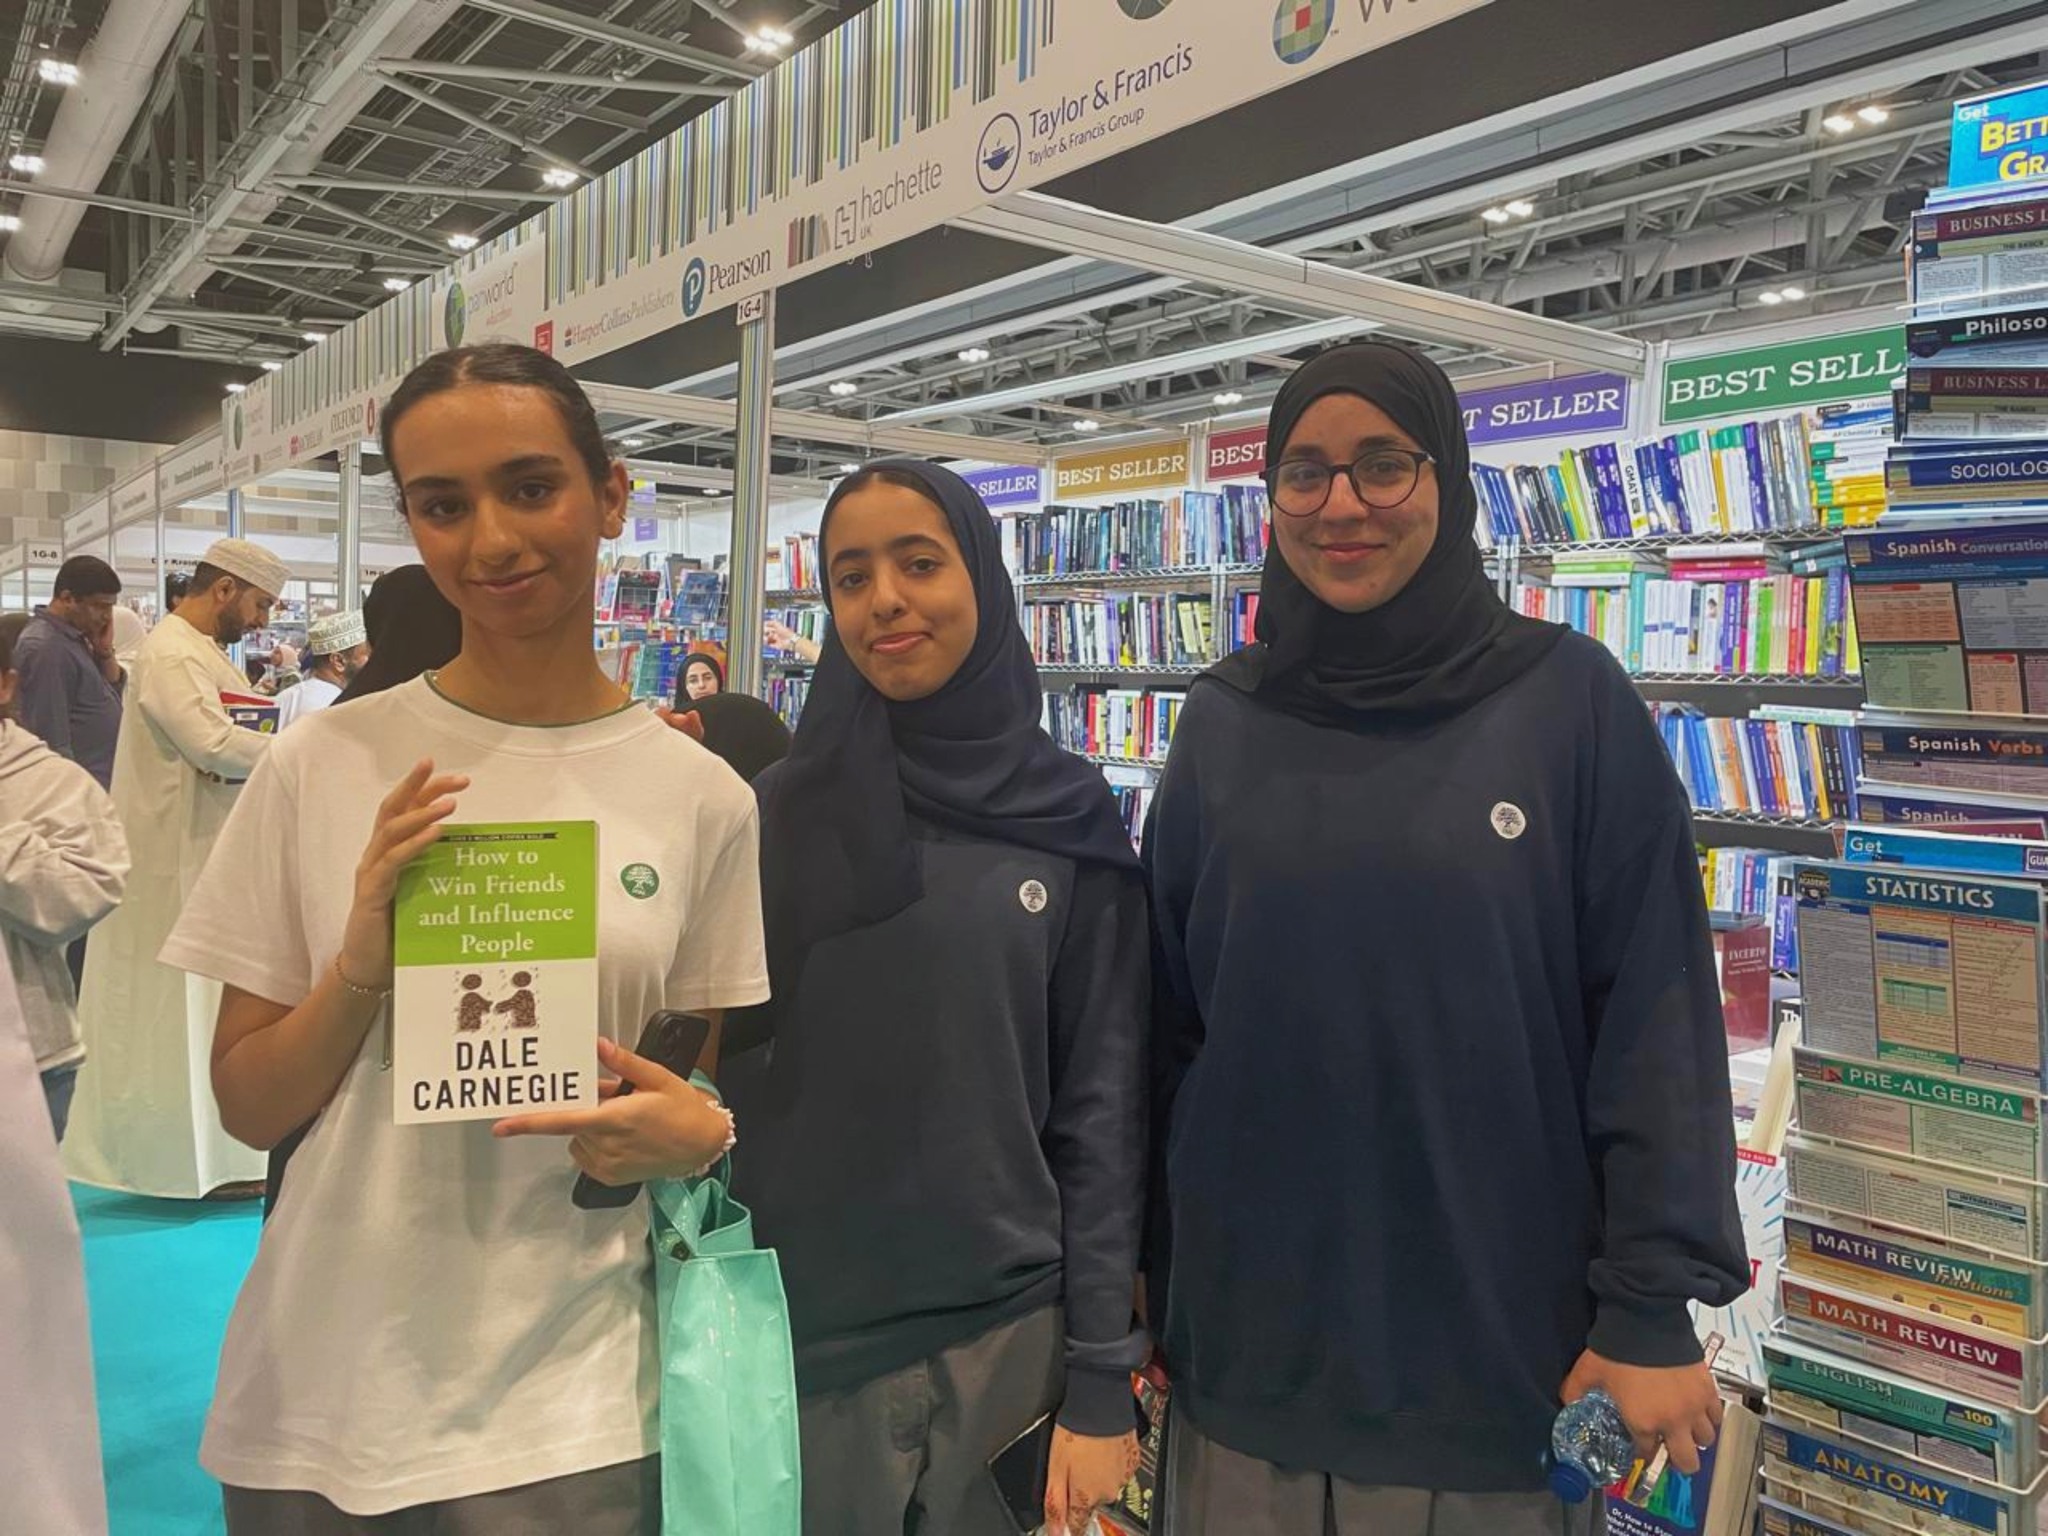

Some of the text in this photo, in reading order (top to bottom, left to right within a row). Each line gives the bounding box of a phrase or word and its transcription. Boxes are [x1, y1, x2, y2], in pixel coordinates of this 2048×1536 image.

[1028, 43, 1193, 140] Taylor & Francis
[1957, 104, 1990, 121] Get
[1028, 106, 1146, 167] Taylor & Francis Group
[860, 159, 942, 221] hachette
[859, 224, 872, 241] UK
[1950, 210, 2035, 233] BUSINESS
[708, 248, 771, 294] Pearson
[738, 297, 762, 321] 1G-4
[1965, 316, 2047, 337] Philoso
[1669, 348, 1906, 405] BEST SELL
[1944, 375, 2029, 390] BUSINESS
[1489, 388, 1621, 428] SELLER
[1210, 441, 1267, 468] BEST
[978, 474, 1037, 497] SELLER
[1058, 454, 1185, 488] BEST SELLER
[1624, 465, 1638, 497] GMAT
[1887, 538, 1957, 558] Spanish
[1908, 735, 2044, 755] Spanish Verbs
[455, 847, 539, 867] How to
[1850, 836, 1883, 854] Get
[429, 873, 566, 897] Win Friends
[1865, 876, 1995, 910] STATISTICS
[418, 902, 575, 927] and Influence
[460, 933, 535, 961] People
[455, 1036, 540, 1072] DALE
[412, 1071, 580, 1112] CARNEGIE
[1849, 1067, 2016, 1115] PRE-ALGEBRA
[1815, 1232, 1973, 1284] MATH REVIEW
[1816, 1300, 1999, 1367] MATH REVIEW
[1801, 1360, 1893, 1397] ENGLISH
[1963, 1409, 1994, 1428] 100
[1813, 1448, 1949, 1506] ANATOMY
